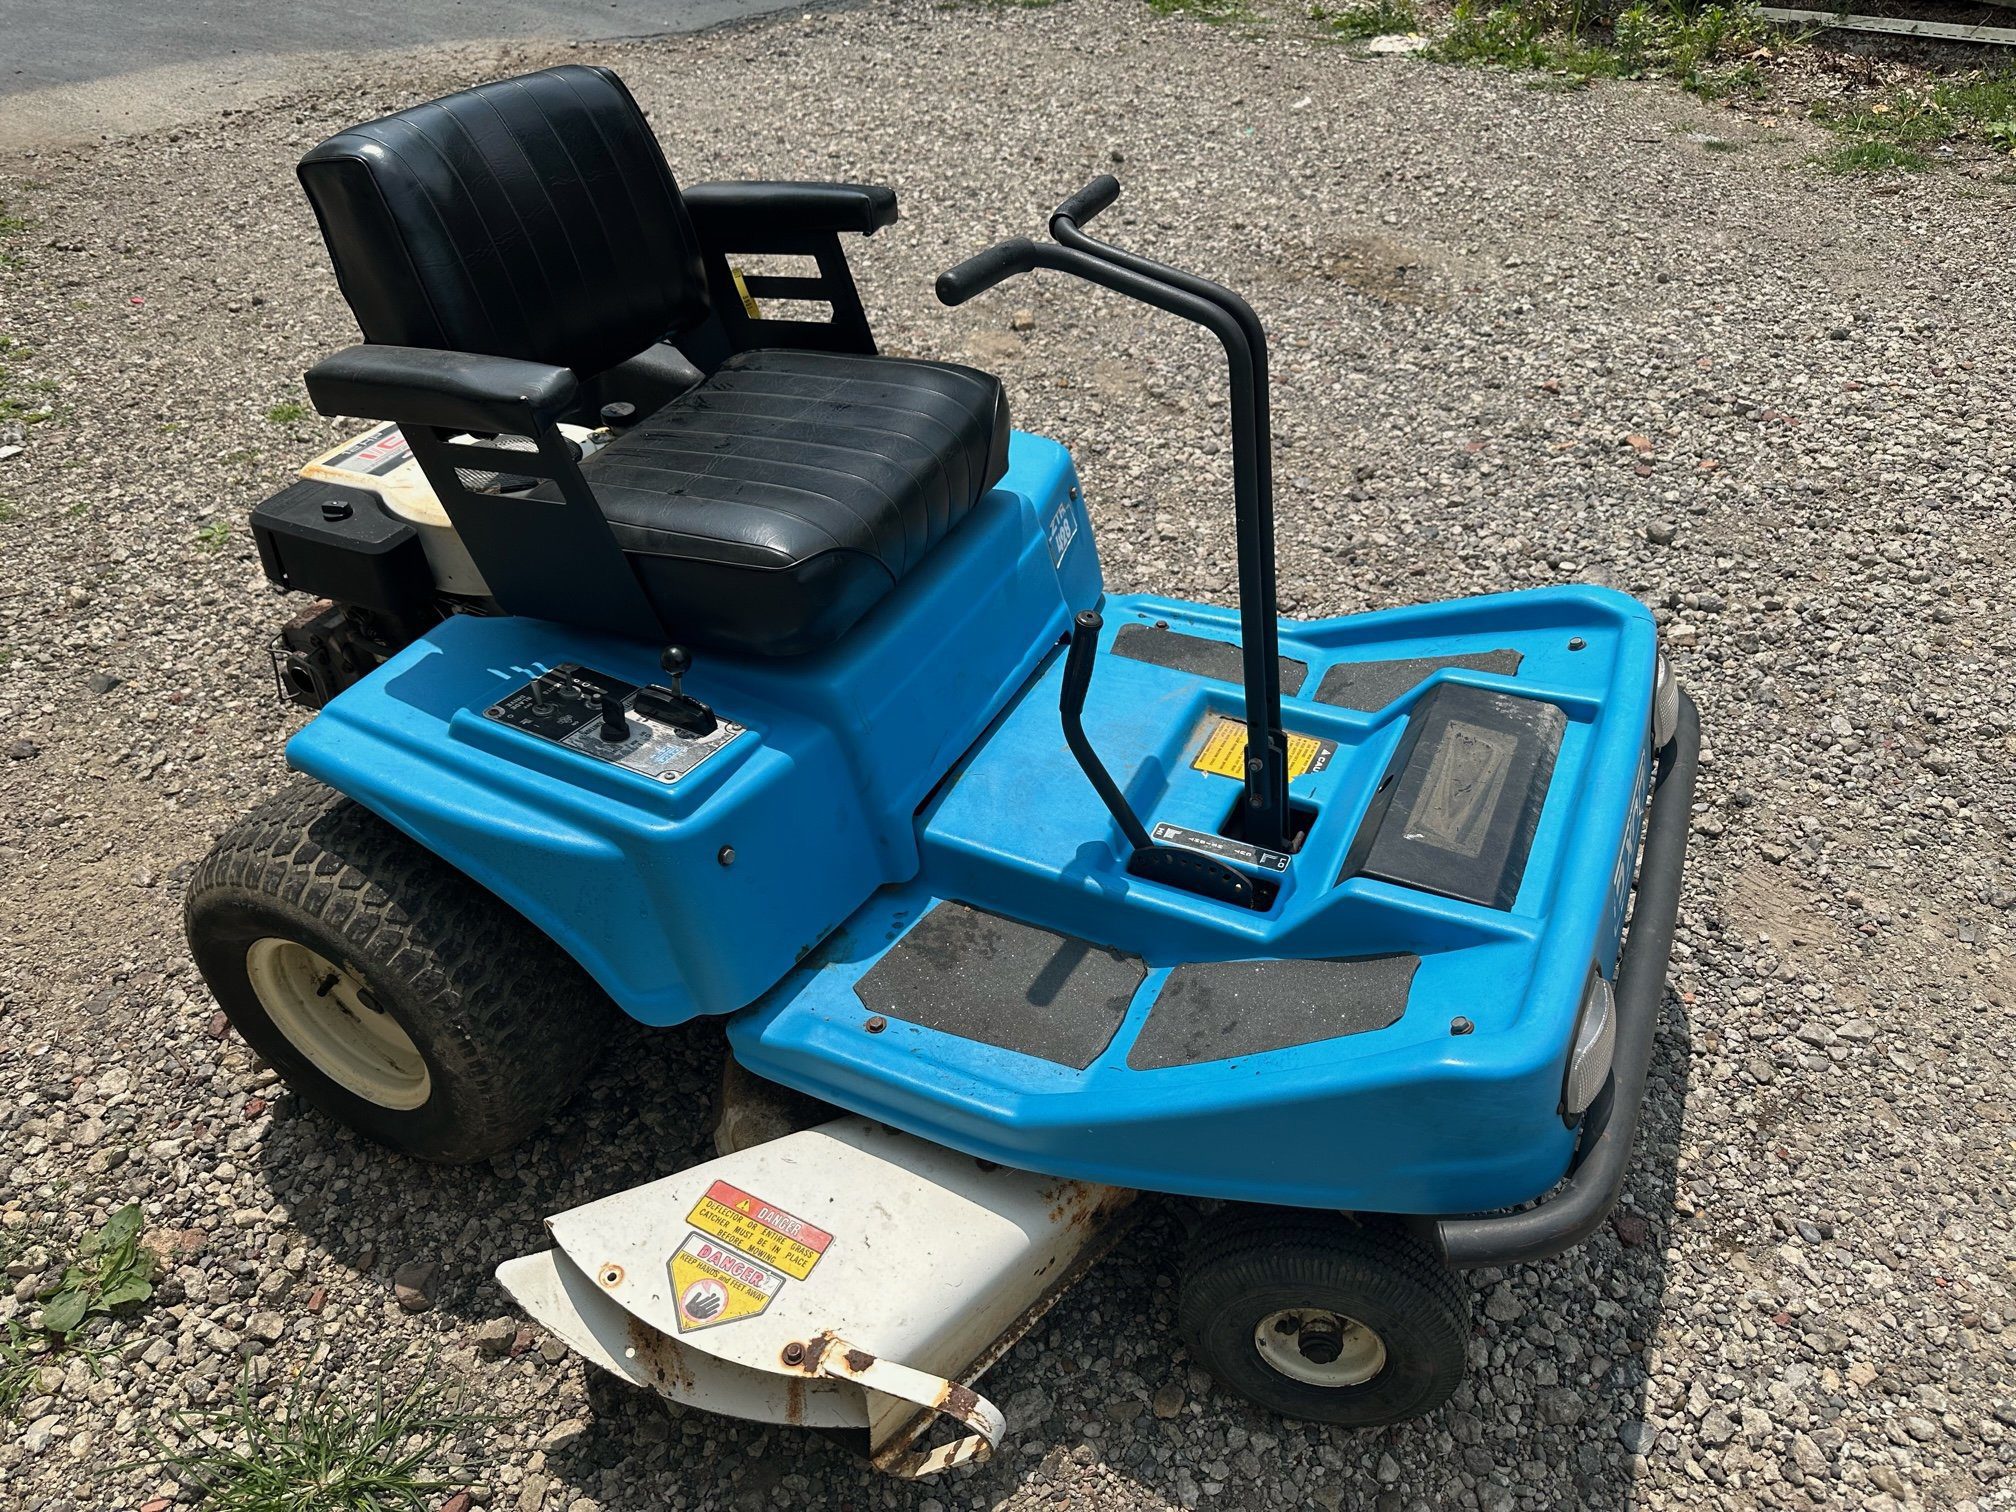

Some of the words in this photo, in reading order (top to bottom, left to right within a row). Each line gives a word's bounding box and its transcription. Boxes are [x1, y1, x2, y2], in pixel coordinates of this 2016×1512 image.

[1277, 858, 1287, 868] LO
[699, 1208, 730, 1228] CATCHER
[734, 1225, 754, 1240] MUST
[757, 1237, 767, 1246] BE
[772, 1245, 781, 1254] IN
[785, 1252, 808, 1268] PLACE
[706, 1200, 743, 1223] DEFLECTOR
[747, 1221, 758, 1231] OR
[761, 1228, 787, 1245] ENTIRE
[791, 1242, 814, 1259] GRASS
[757, 1207, 802, 1236] DANGER
[697, 1244, 764, 1288] DANGER
[717, 1228, 743, 1246] BEFORE
[748, 1245, 776, 1264] MOWING
[680, 1253, 697, 1265] KEEP
[696, 1261, 720, 1278] HANDS
[718, 1273, 730, 1284] and
[730, 1279, 745, 1293] FEET
[745, 1287, 765, 1301] AWAY
